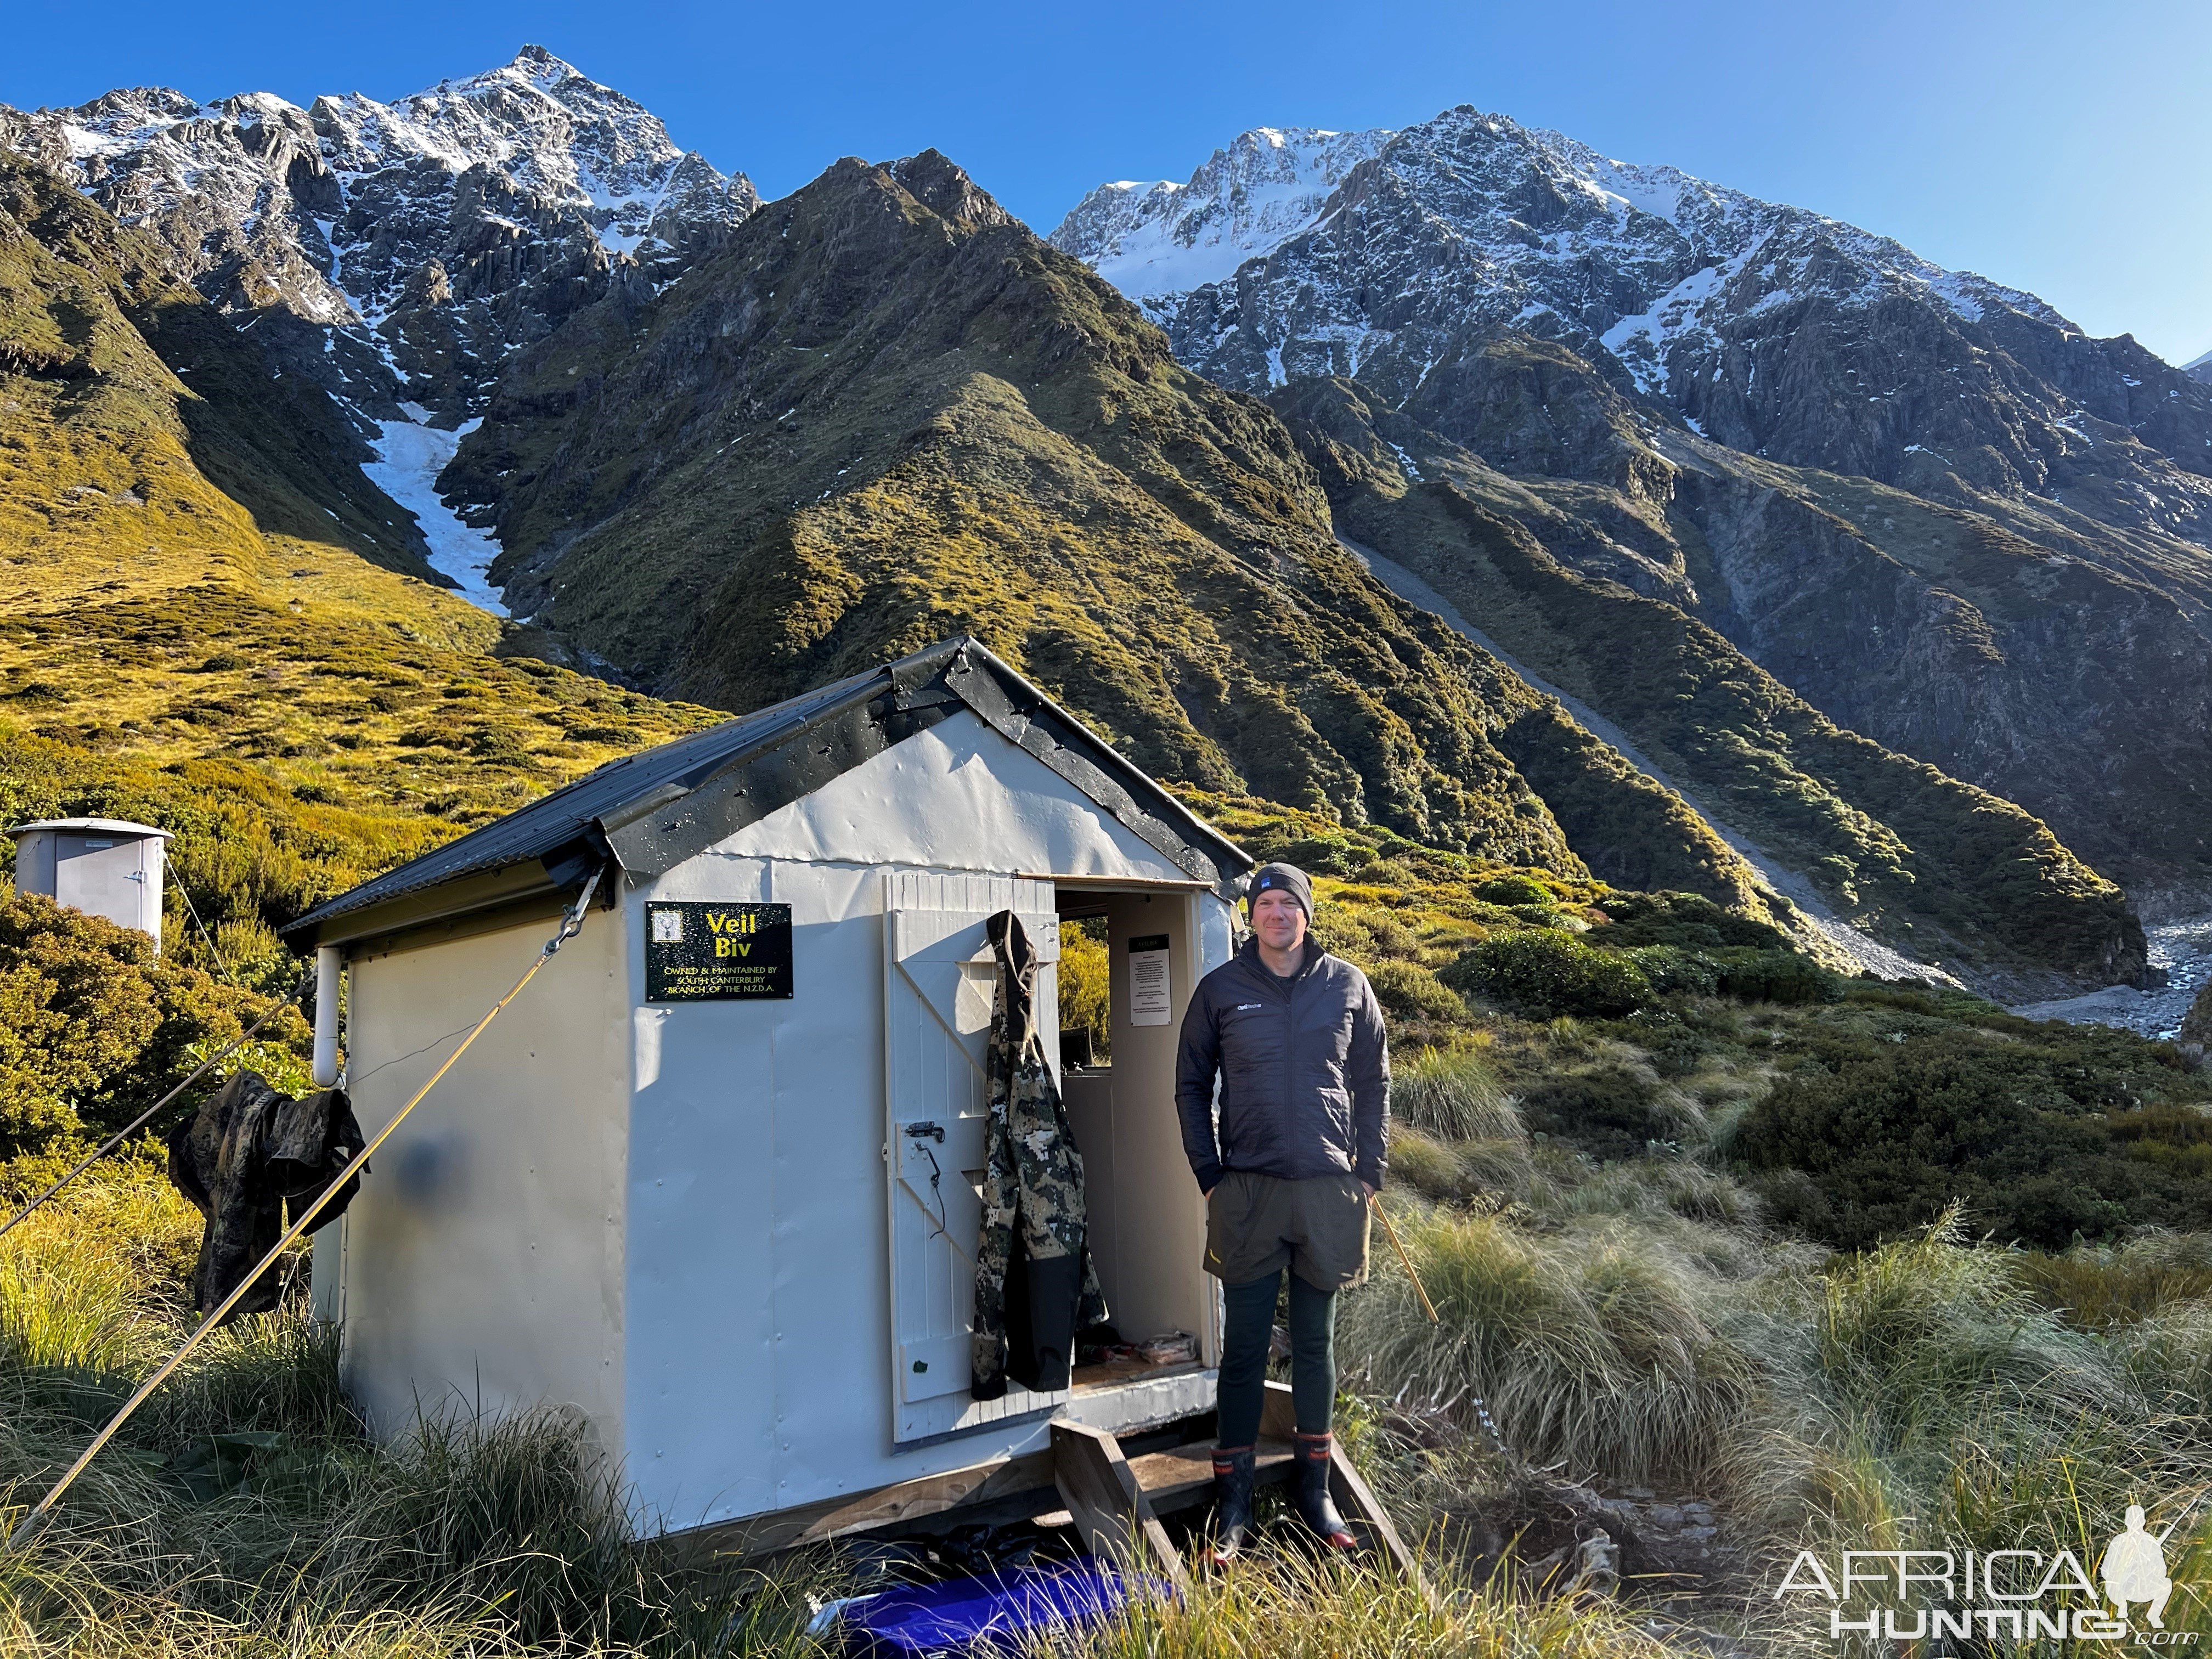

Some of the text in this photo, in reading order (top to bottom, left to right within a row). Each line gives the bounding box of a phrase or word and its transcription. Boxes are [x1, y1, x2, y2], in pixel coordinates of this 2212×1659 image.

[705, 913, 755, 933] Veil
[715, 938, 752, 957] Biv
[664, 967, 698, 975] OWNED
[712, 966, 765, 974] MAINTAINED
[676, 976, 765, 985] SOUTH CANTERBURY
[668, 986, 706, 994] BRANCH
